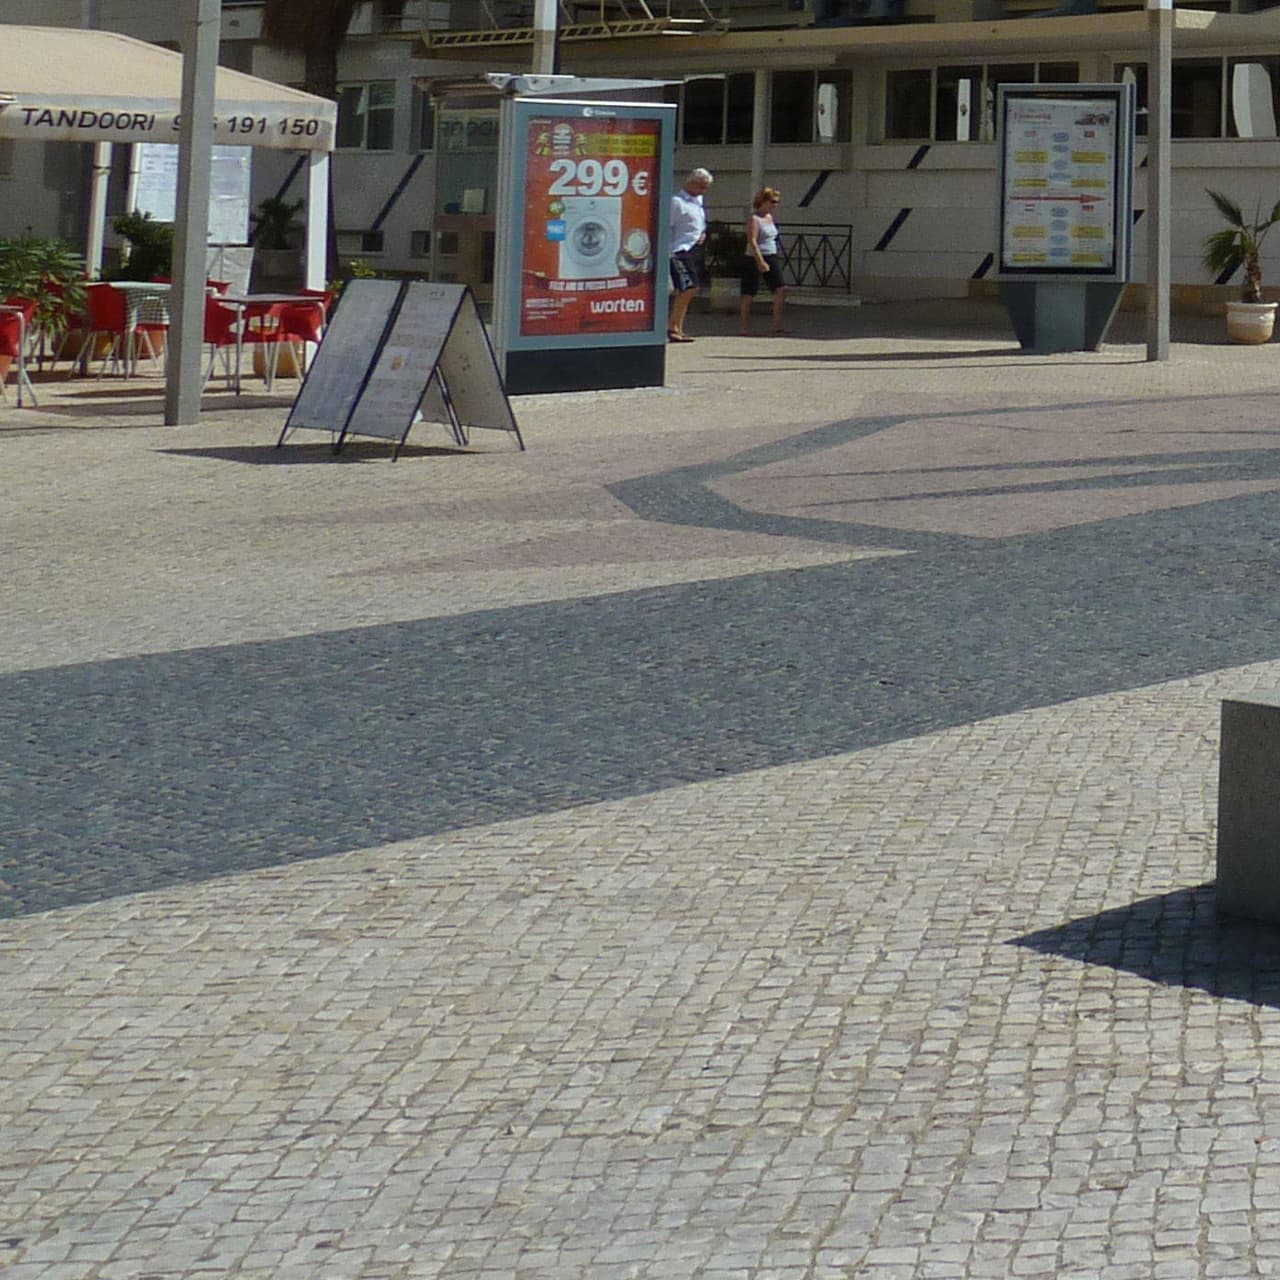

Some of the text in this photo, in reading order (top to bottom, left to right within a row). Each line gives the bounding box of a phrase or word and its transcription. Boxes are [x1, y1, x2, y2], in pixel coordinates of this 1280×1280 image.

[22, 108, 155, 132] TANDOORI
[228, 116, 267, 133] 191
[279, 118, 319, 136] 150
[590, 298, 645, 314] worten
